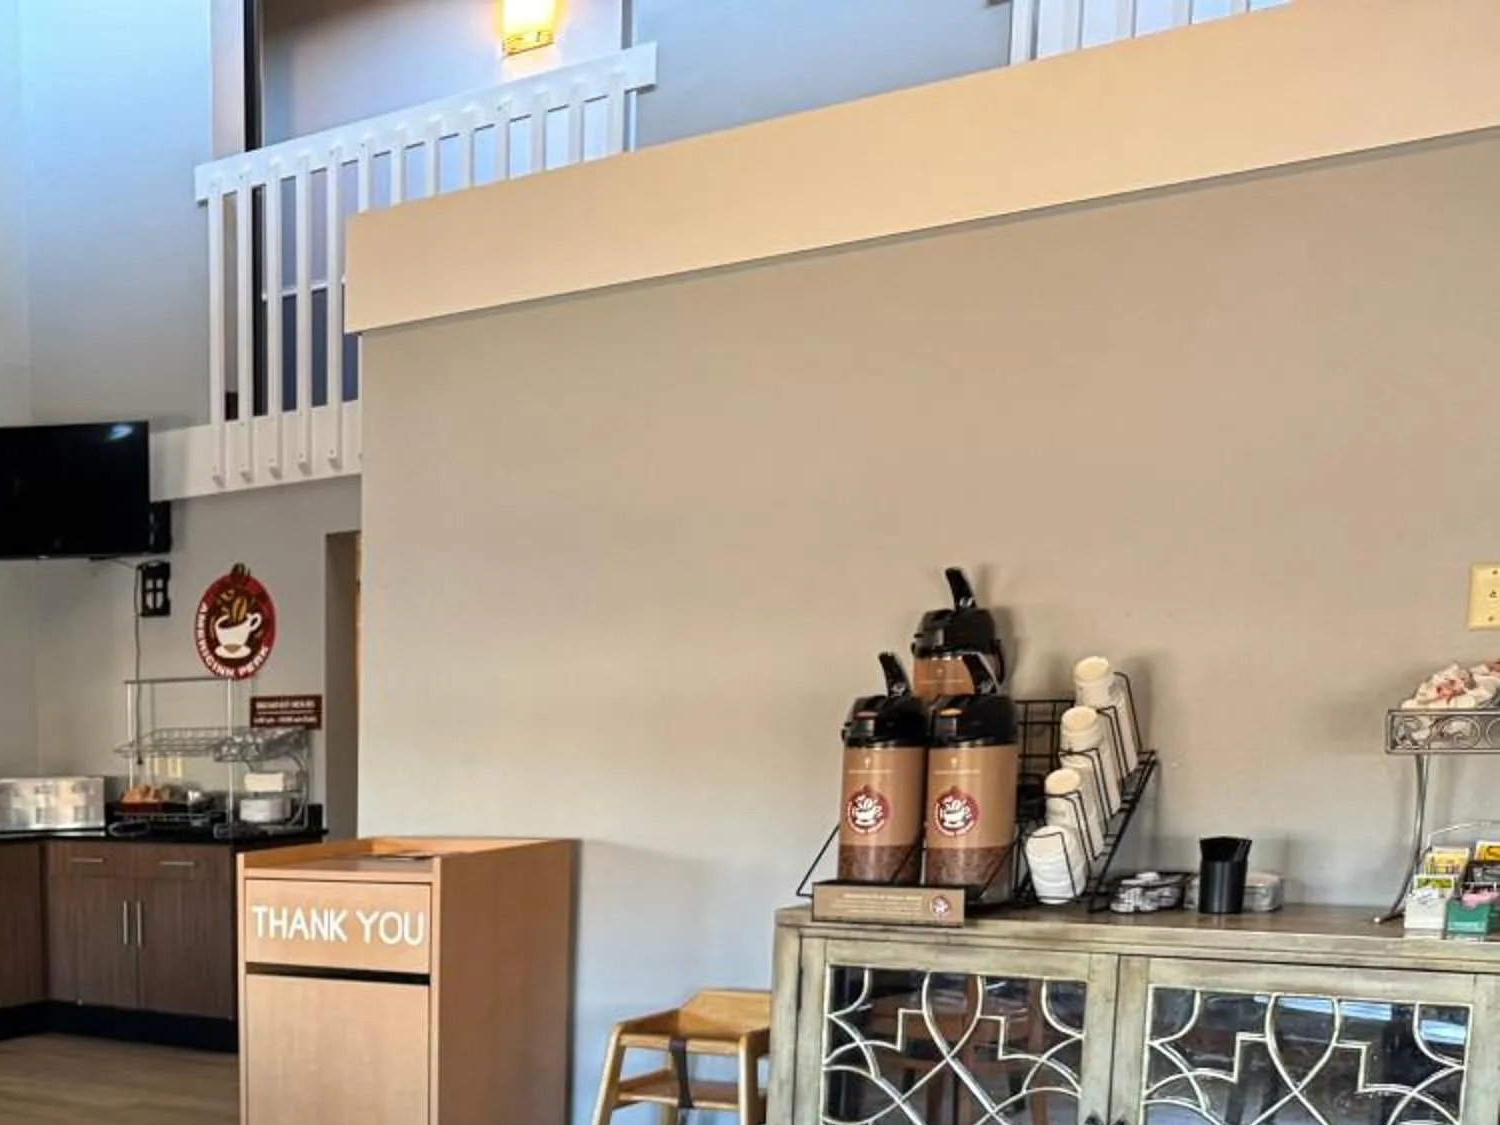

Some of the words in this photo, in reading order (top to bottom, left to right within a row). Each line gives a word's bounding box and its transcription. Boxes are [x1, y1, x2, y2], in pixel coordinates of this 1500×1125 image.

[237, 644, 269, 677] PERK
[252, 906, 348, 942] THANK
[355, 910, 424, 946] YOU
